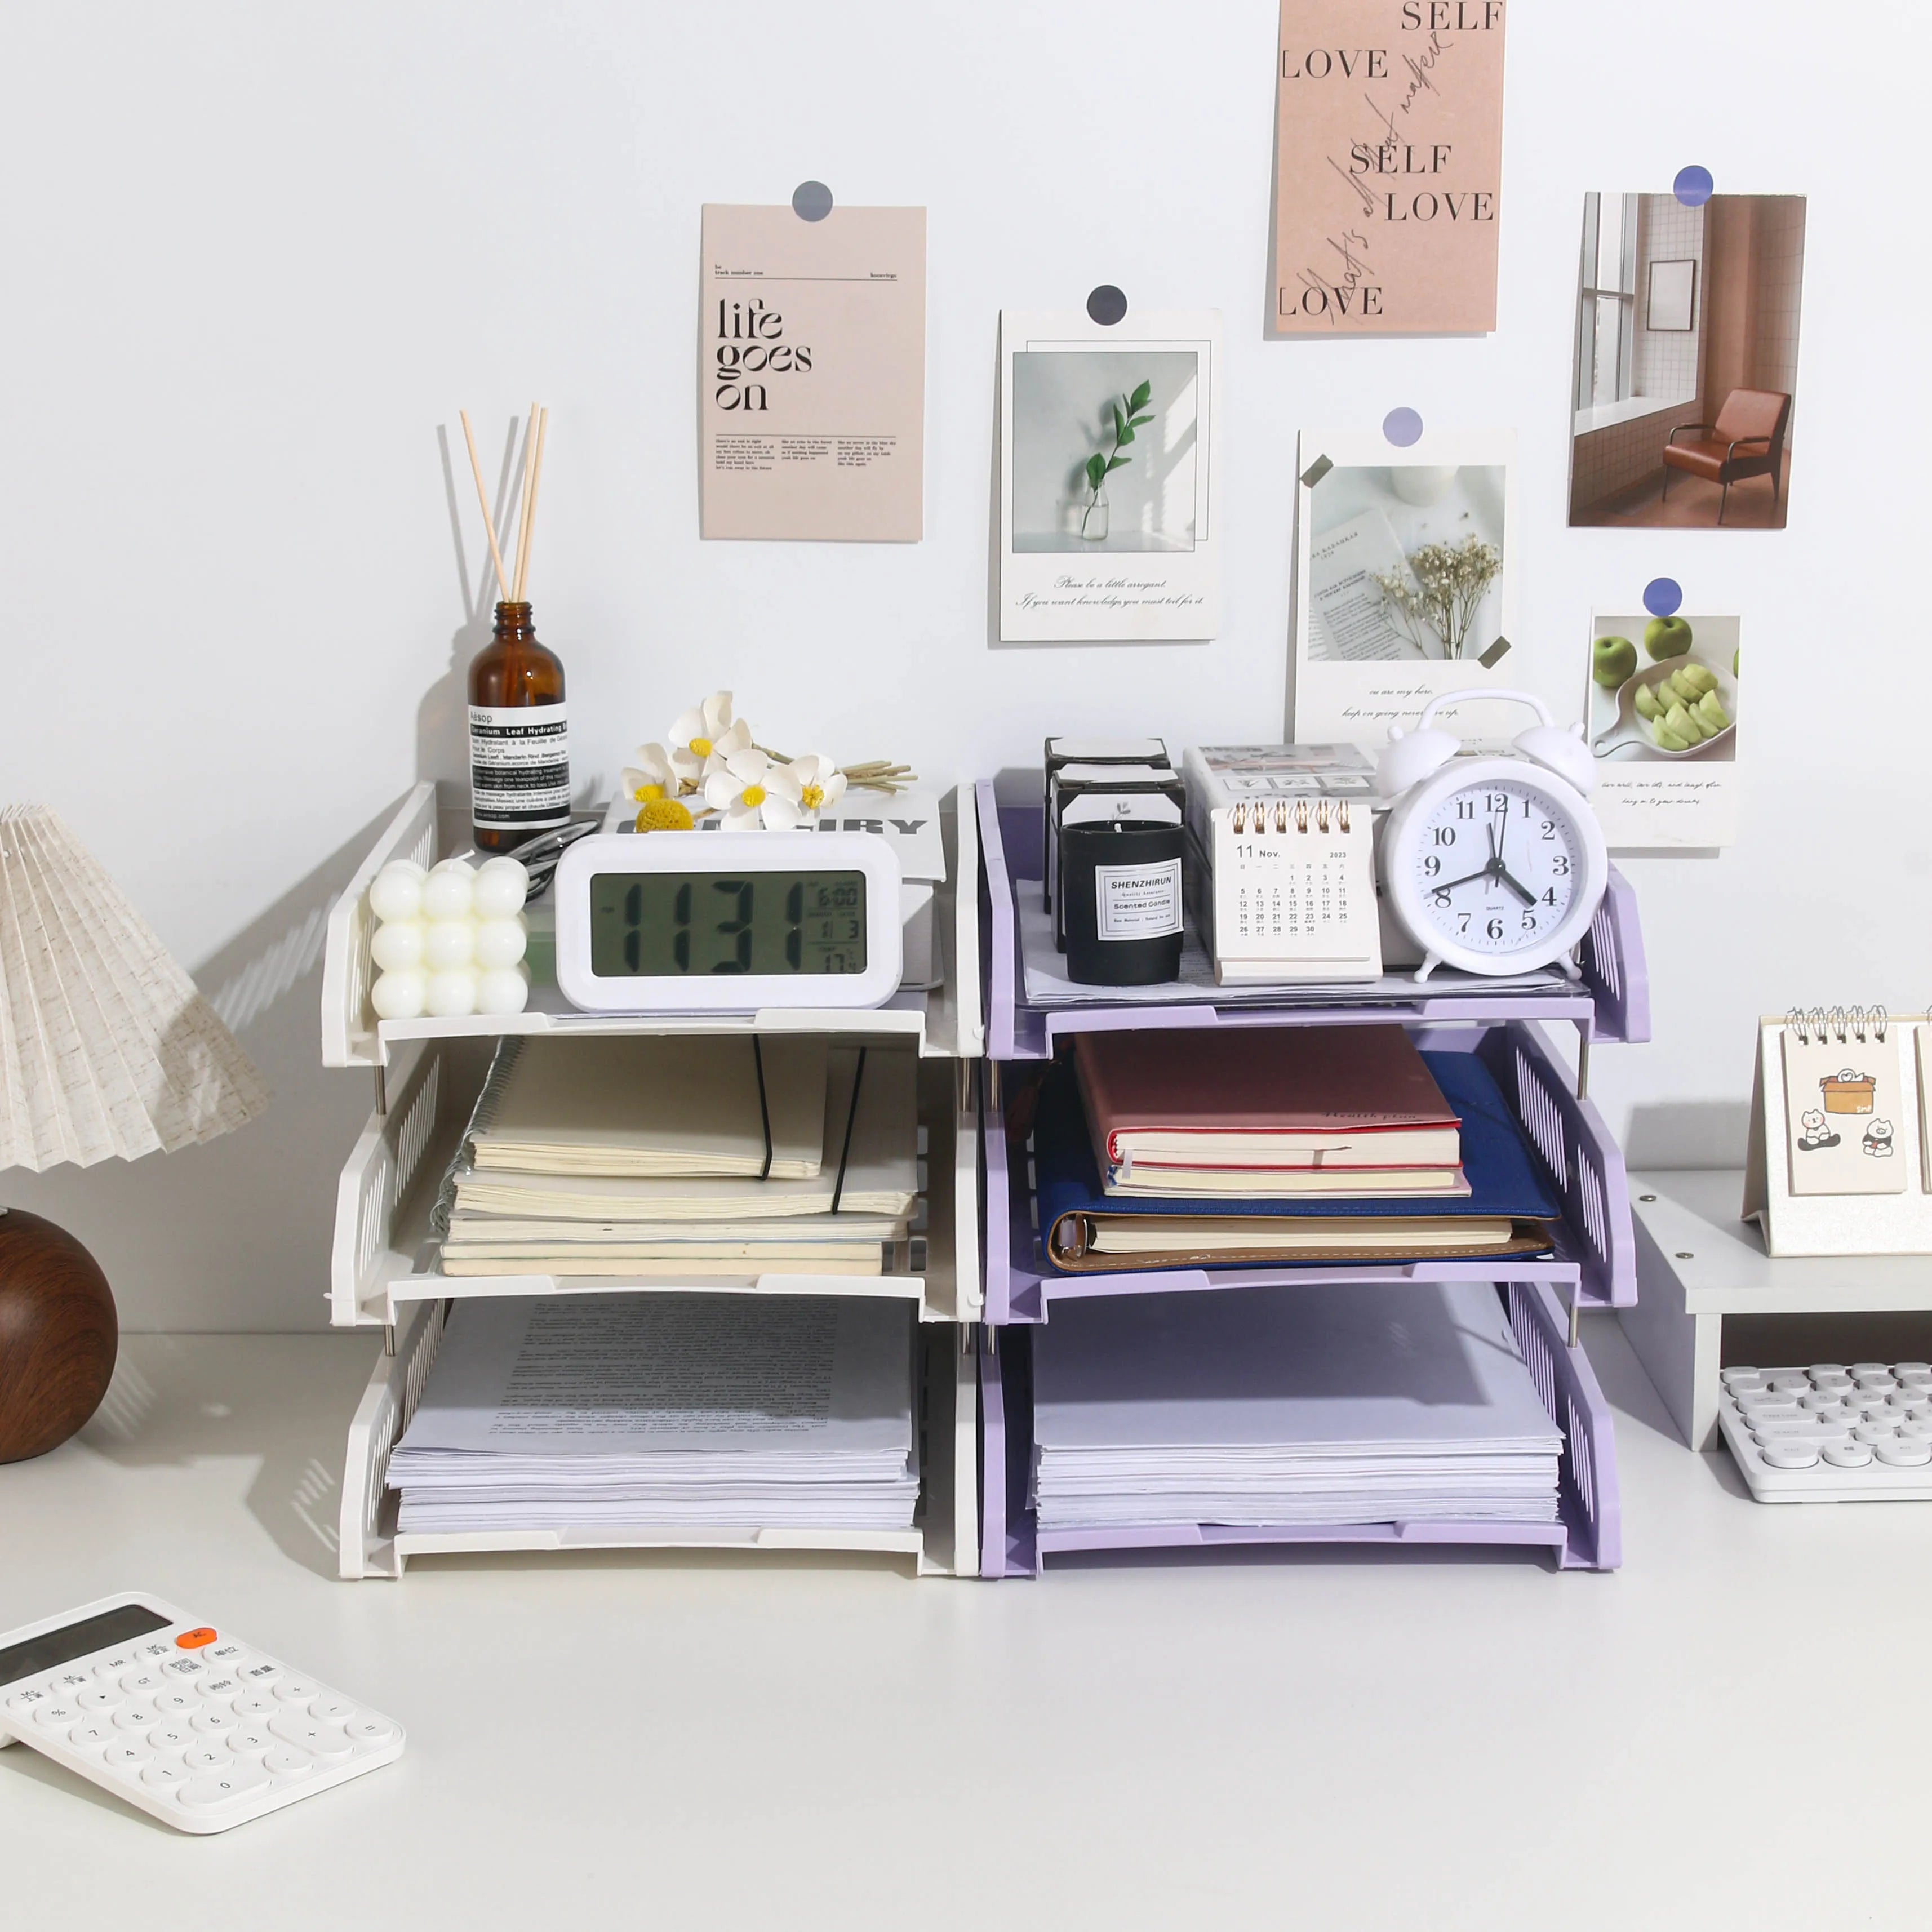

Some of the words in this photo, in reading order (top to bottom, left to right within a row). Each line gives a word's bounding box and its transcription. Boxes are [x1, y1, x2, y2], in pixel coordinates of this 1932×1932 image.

[1402, 1, 1503, 30] SELF
[1282, 50, 1388, 78] LOVE
[1351, 145, 1451, 174] SELF
[1384, 193, 1494, 221] LOVE
[1280, 287, 1383, 315] LOVE
[718, 298, 783, 339] life
[717, 345, 812, 380] goes
[716, 384, 768, 410] on
[1054, 575, 1083, 589] Please
[1086, 578, 1096, 588] be
[1105, 578, 1127, 588] little
[1033, 600, 1049, 609] you
[1121, 599, 1139, 608] you
[1177, 594, 1193, 608] for
[1397, 689, 1412, 698] my
[1342, 707, 1360, 720] keep
[1375, 708, 1398, 719] going
[505, 727, 525, 736] Leaf
[527, 724, 562, 736] Hydrating
[1456, 801, 1475, 819] 11
[1485, 793, 1508, 812] 12
[1522, 800, 1531, 818] 1
[1433, 827, 1456, 846] 10
[1541, 821, 1555, 840] 2
[1237, 845, 1253, 858] 11
[1424, 856, 1441, 876] 9
[1553, 856, 1569, 875] 3
[1111, 876, 1172, 889] SHENZHIRUN
[1114, 901, 1147, 910] Scented
[1148, 899, 1171, 908] Candle
[1435, 887, 1451, 908] 8
[1542, 887, 1557, 906] 4
[849, 920, 859, 939] 3
[1458, 913, 1471, 932] 7
[1487, 919, 1503, 939] 6
[1522, 910, 1536, 930] 5
[109, 1659, 126, 1668] MR
[220, 1780, 231, 1790] 0
